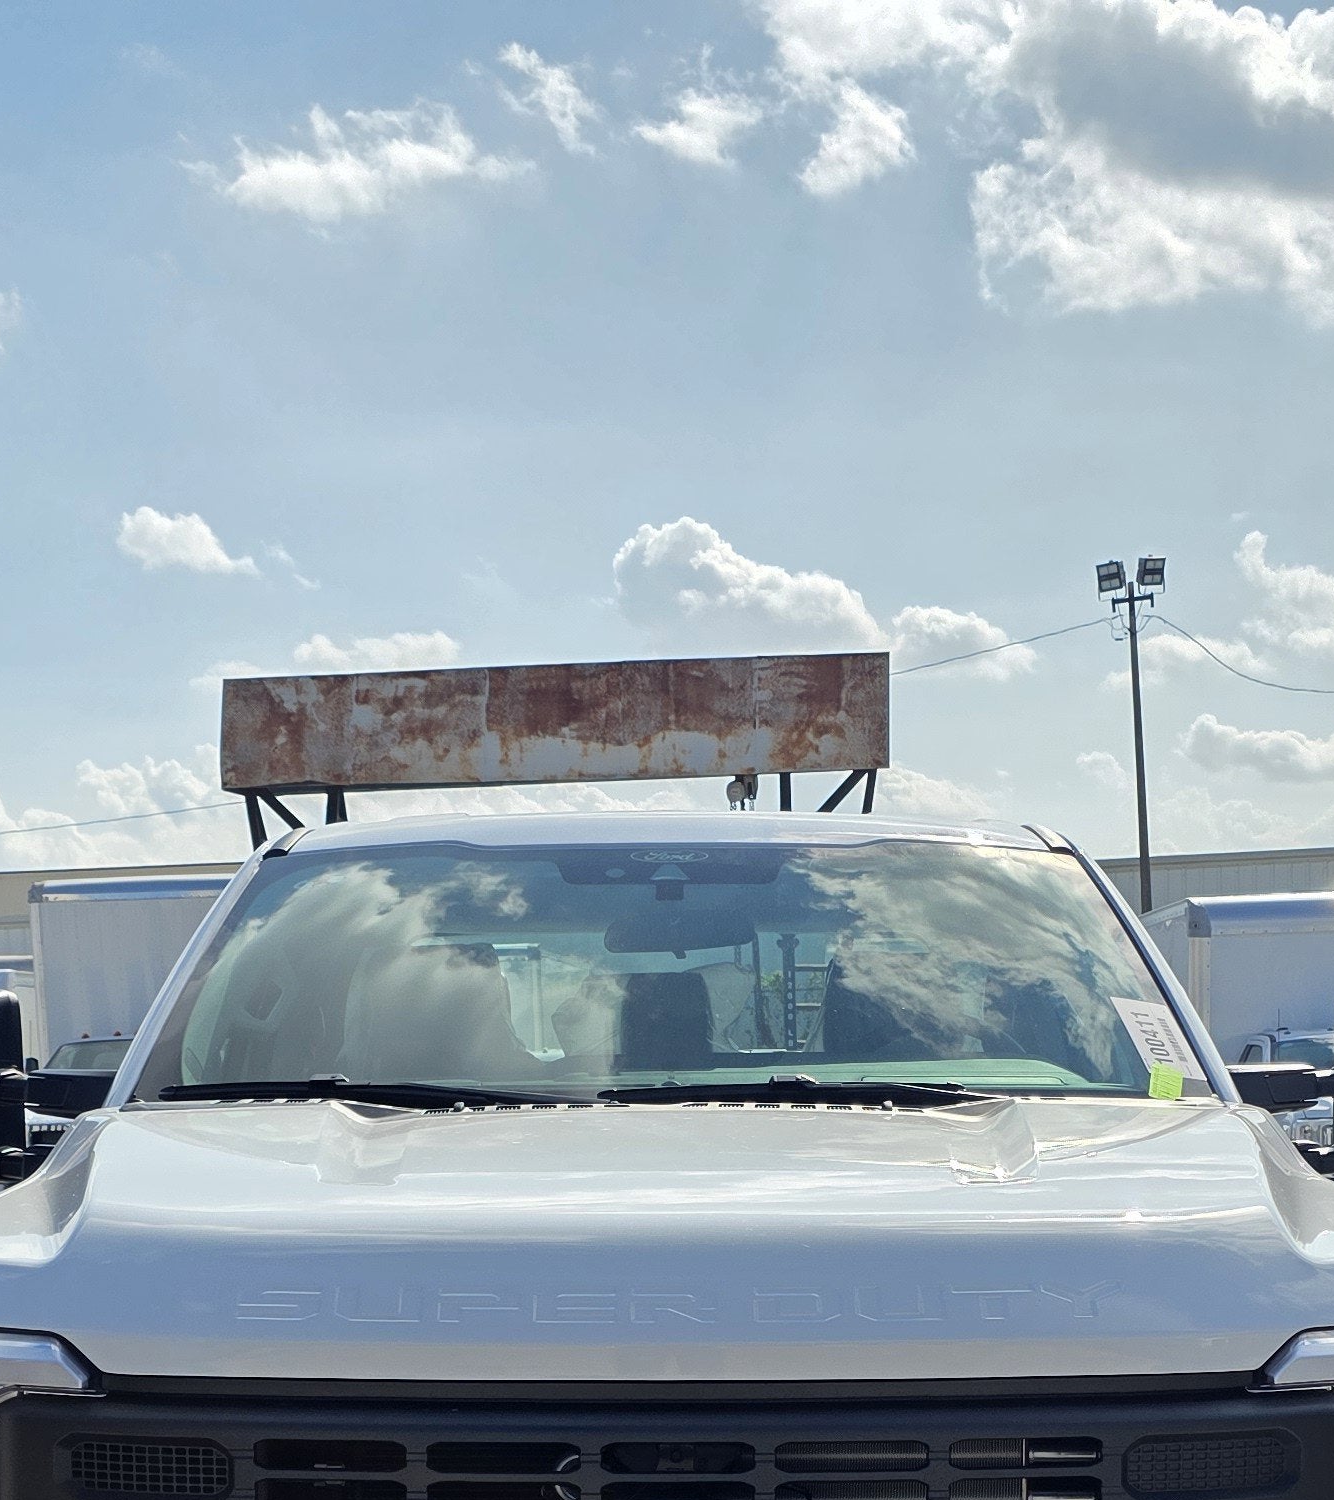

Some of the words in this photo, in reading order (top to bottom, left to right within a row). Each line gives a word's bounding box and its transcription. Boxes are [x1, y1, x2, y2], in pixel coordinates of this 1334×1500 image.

[644, 851, 697, 861] Ford
[1130, 1011, 1174, 1065] 100411
[236, 1286, 718, 1325] SUPER
[753, 1279, 1124, 1324] DUTY
